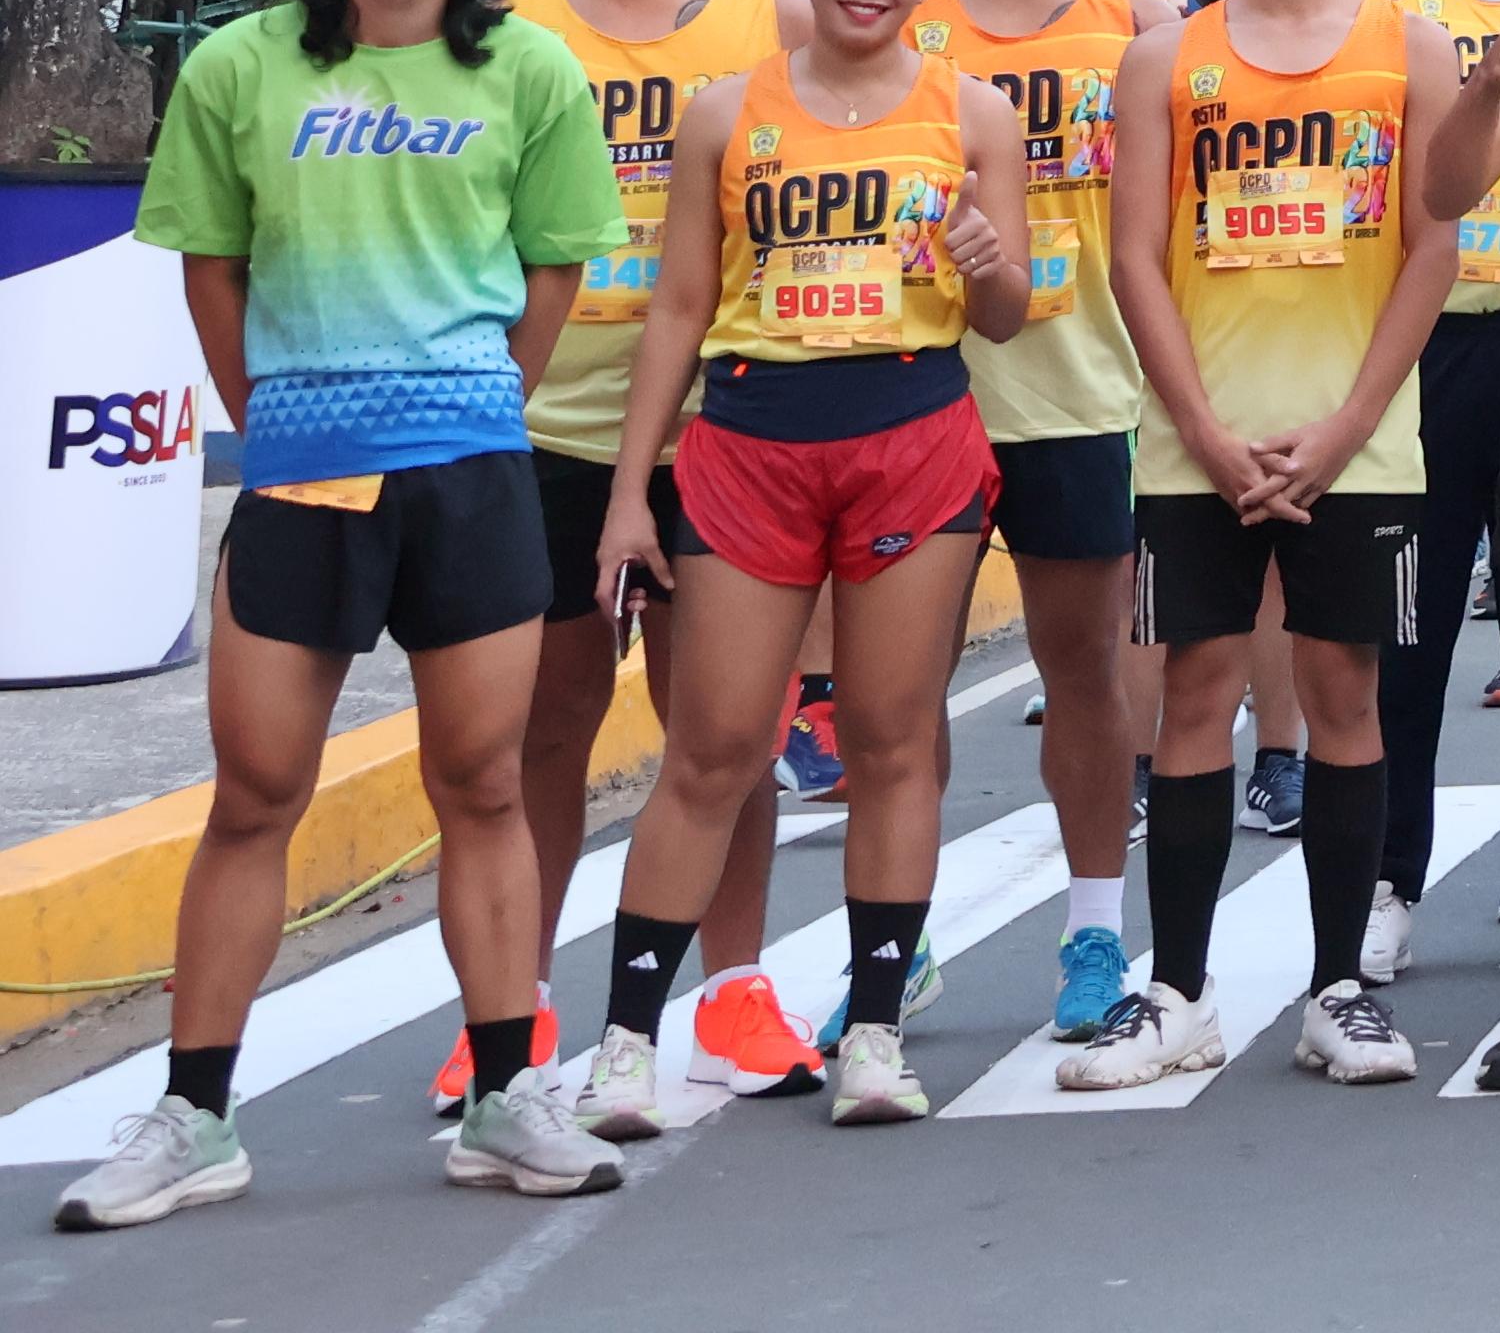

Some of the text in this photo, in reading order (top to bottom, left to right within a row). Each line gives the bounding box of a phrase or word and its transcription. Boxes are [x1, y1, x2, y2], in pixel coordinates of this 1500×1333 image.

[289, 102, 486, 161] Fitbar
[745, 159, 782, 182] 85TH
[1239, 173, 1271, 188] QCPD
[744, 169, 891, 247] QCPD
[1225, 202, 1326, 239] 9055
[775, 283, 884, 319] 9035
